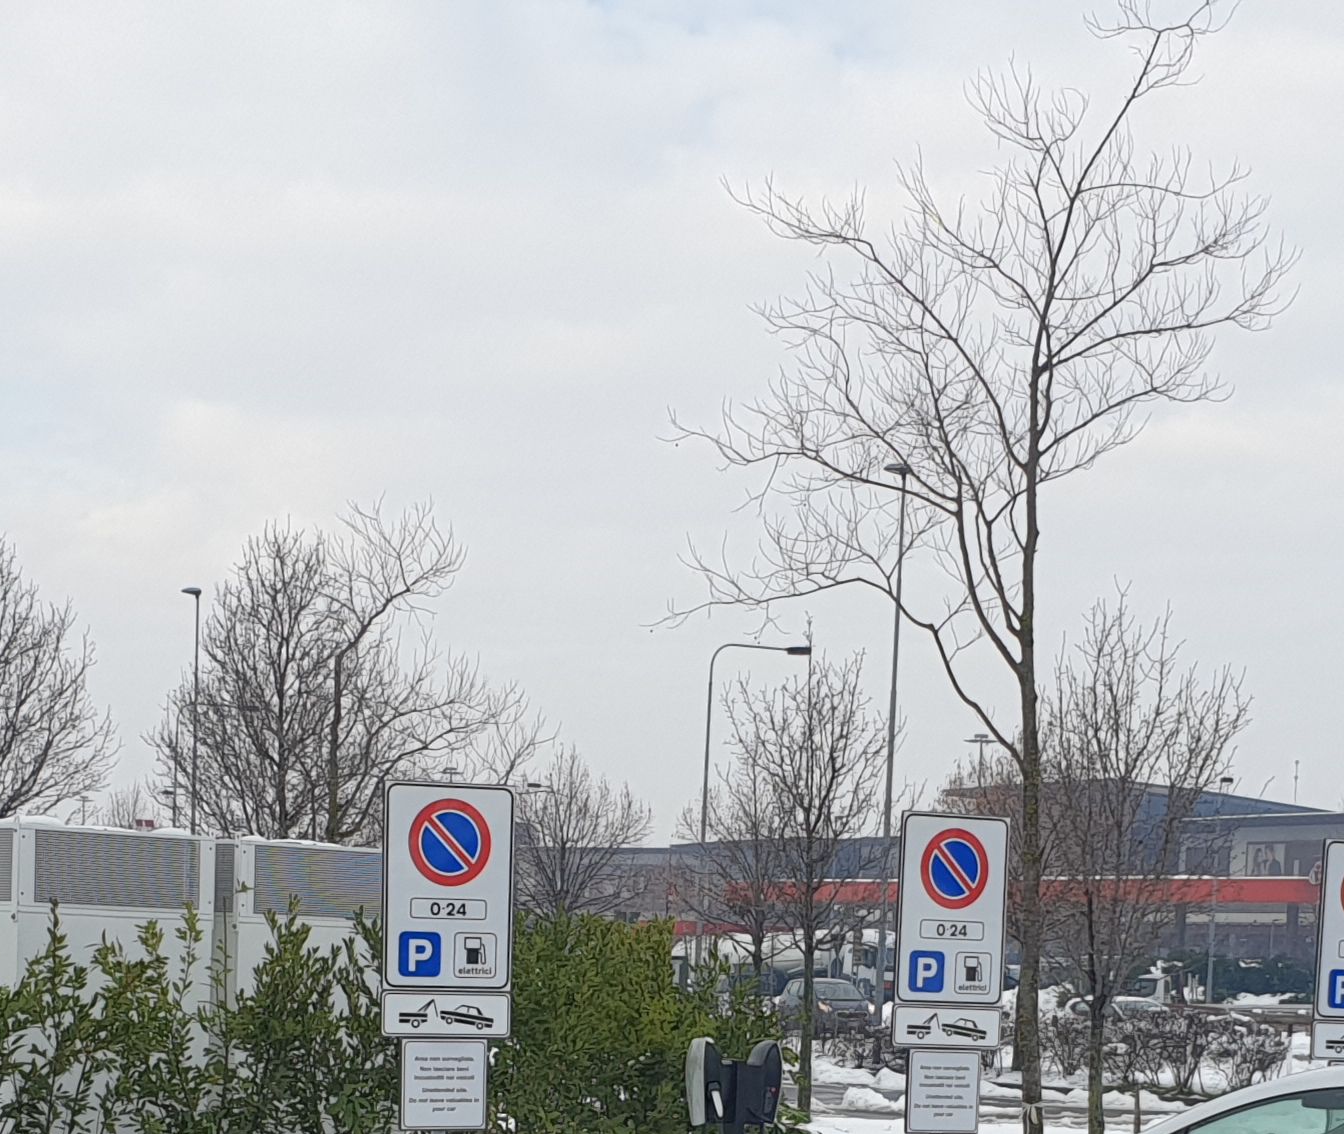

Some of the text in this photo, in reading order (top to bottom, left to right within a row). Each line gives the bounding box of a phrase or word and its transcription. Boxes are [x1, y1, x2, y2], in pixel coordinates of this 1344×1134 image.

[430, 902, 467, 916] 0-24
[936, 923, 968, 937] 0-24
[408, 938, 433, 972] P
[916, 957, 938, 988] P
